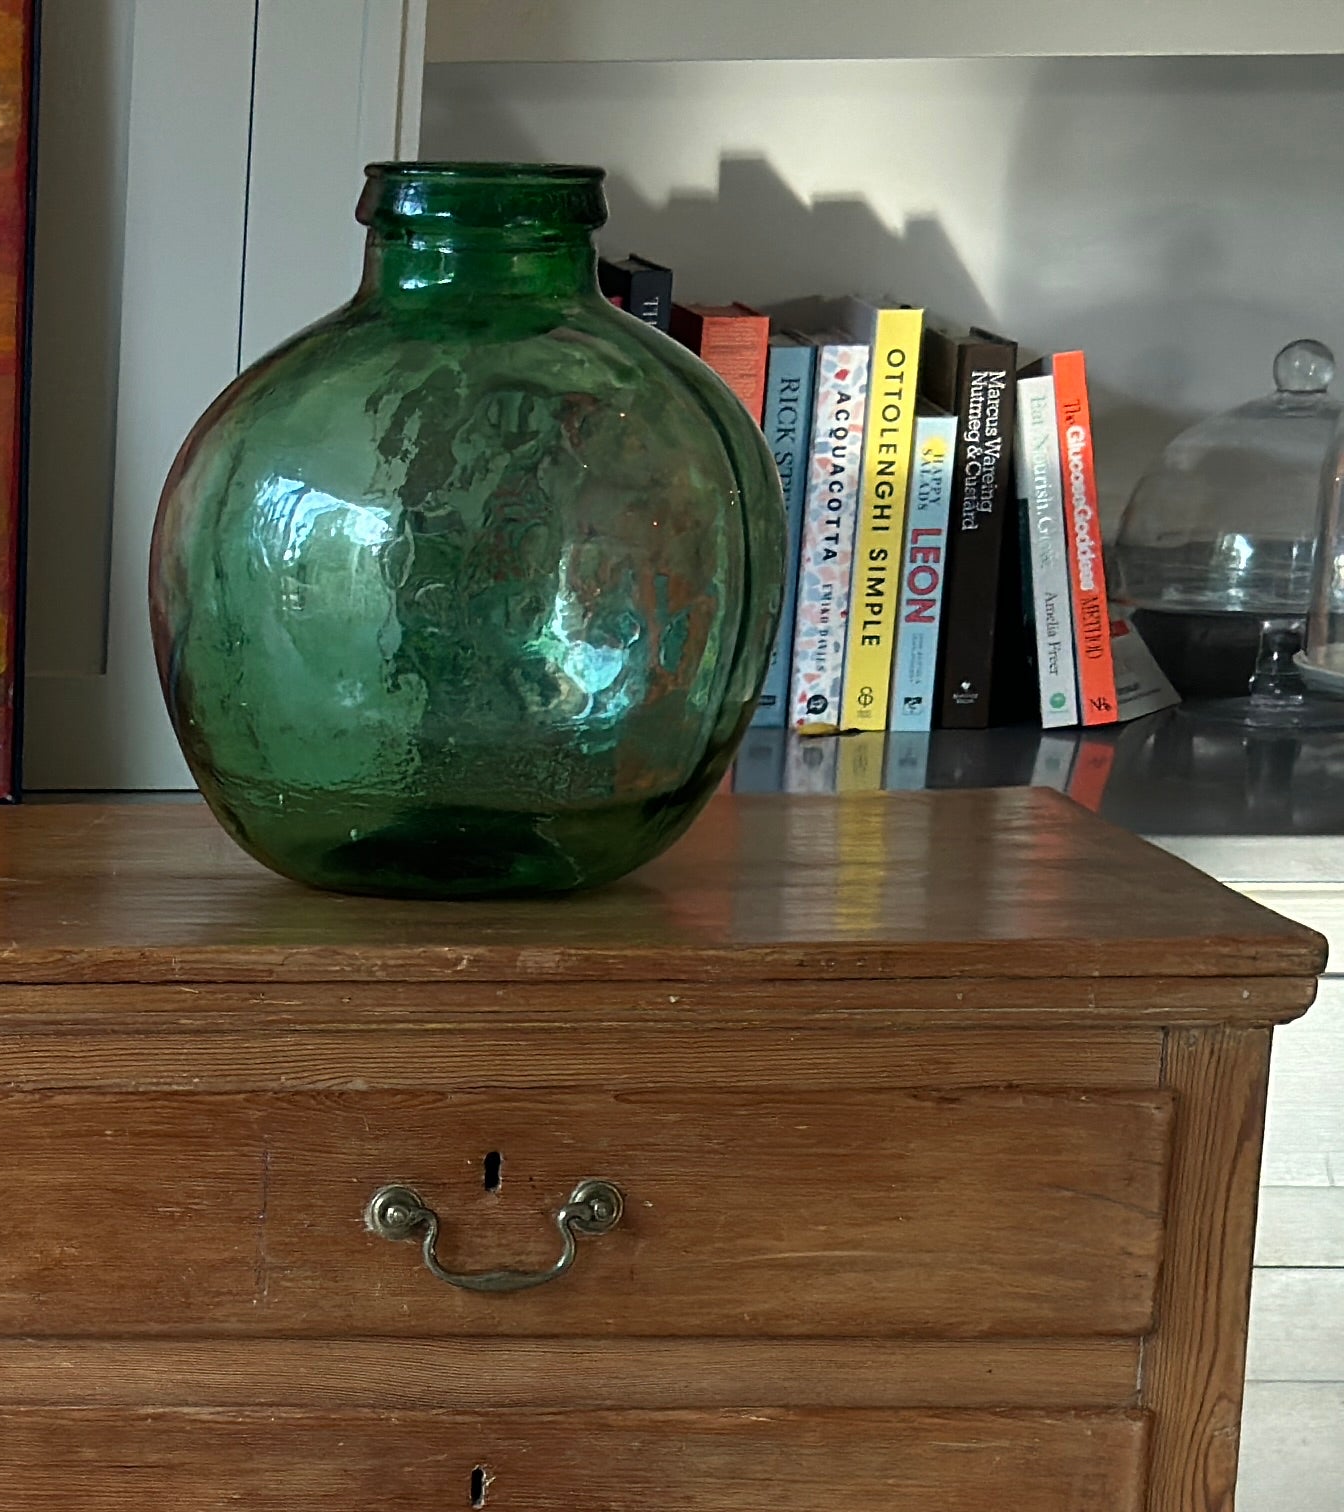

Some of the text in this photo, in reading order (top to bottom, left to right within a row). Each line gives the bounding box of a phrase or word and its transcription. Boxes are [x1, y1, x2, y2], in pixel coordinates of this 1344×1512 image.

[775, 377, 800, 443] RICK
[962, 370, 987, 530] Nutmeg & Custard
[977, 370, 1006, 513] Marcus Wareing
[823, 390, 852, 561] ACQUACOTTA
[862, 349, 906, 647] OTTOLENGHI SIMPLE
[928, 454, 944, 505] HAPPY
[905, 528, 943, 624] LEON
[1045, 592, 1059, 638] Amelia
